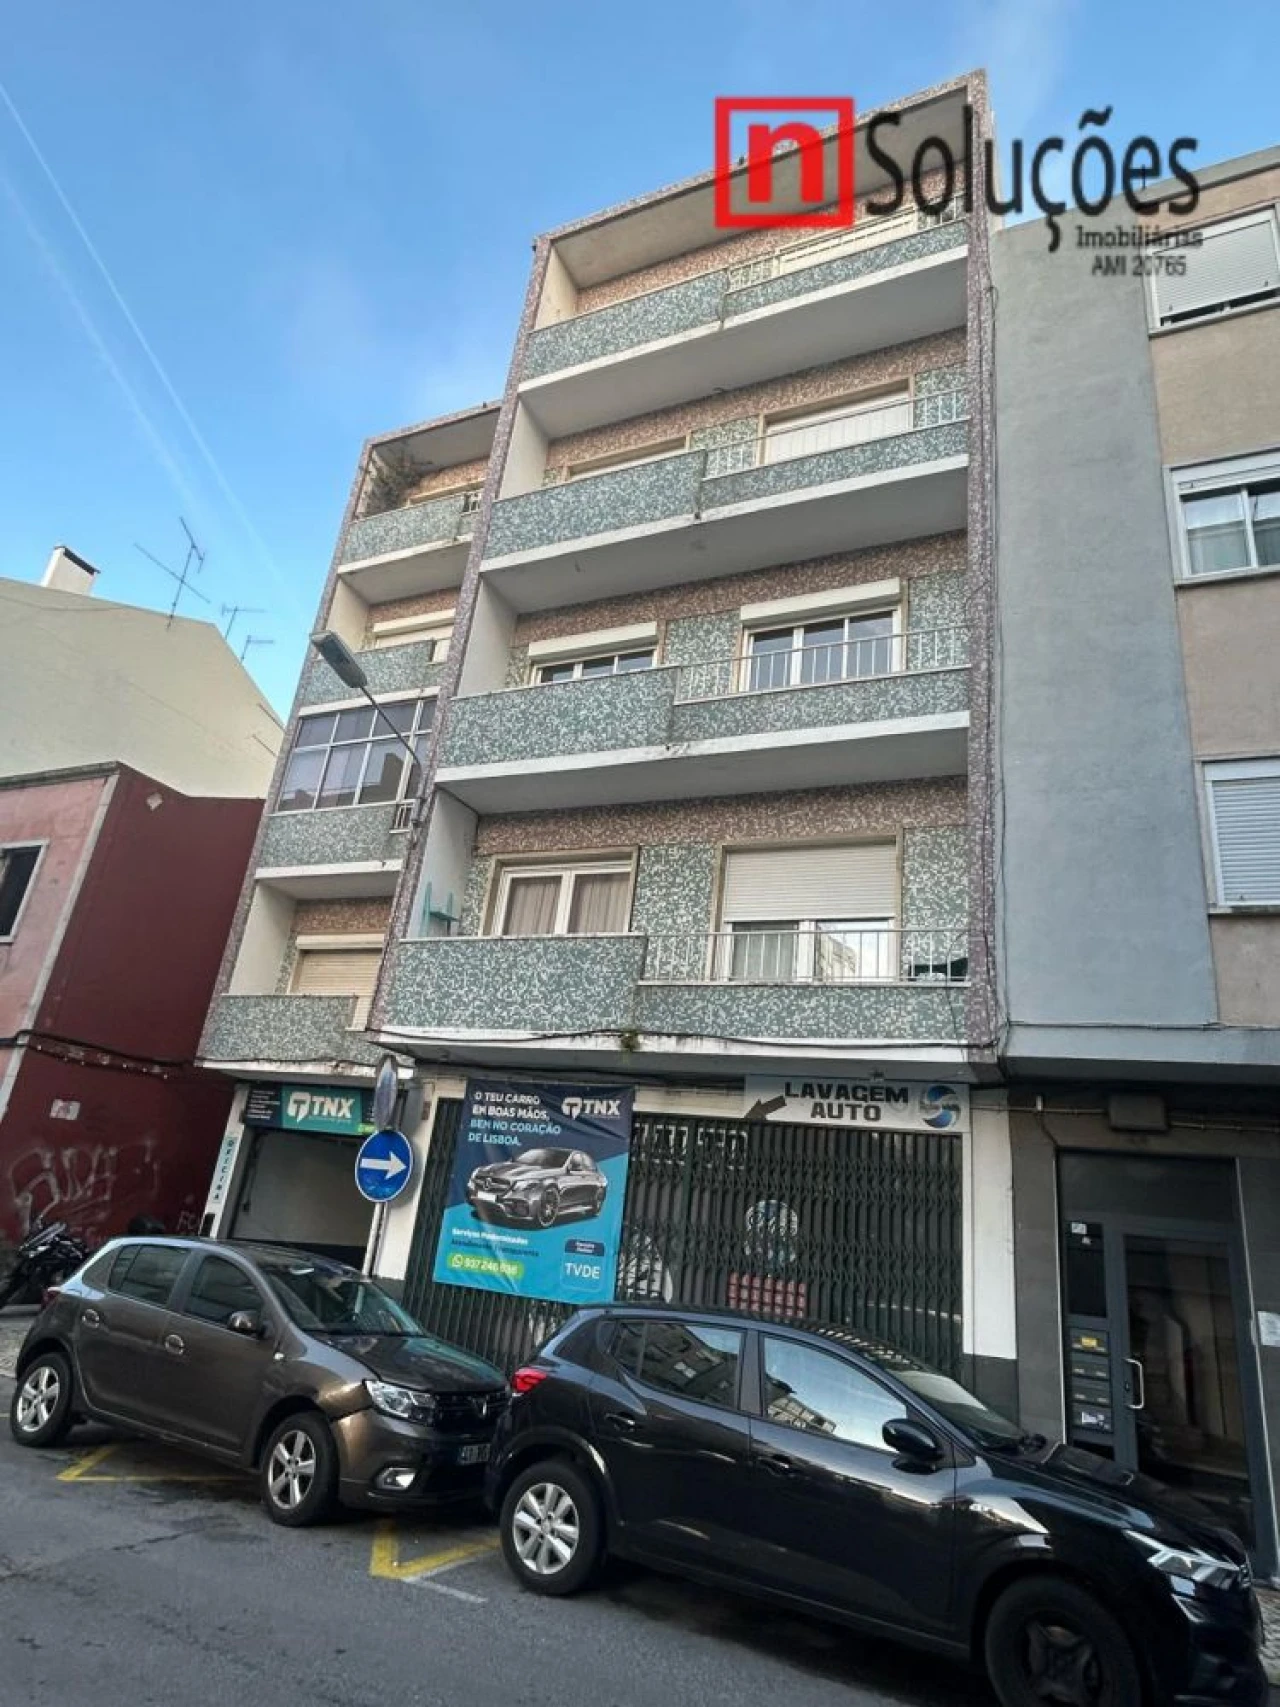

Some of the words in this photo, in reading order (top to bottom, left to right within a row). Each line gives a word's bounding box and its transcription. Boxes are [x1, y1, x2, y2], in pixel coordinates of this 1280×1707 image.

[505, 1093, 541, 1106] CARRO
[784, 1081, 909, 1103] LAVAGEM
[311, 1095, 355, 1119] TNX
[487, 1105, 516, 1118] BOAS
[583, 1099, 621, 1116] TNX
[810, 1102, 882, 1122] AUTO
[492, 1120, 509, 1132] NO
[510, 1121, 561, 1135] CORAÇÃO
[468, 1131, 482, 1143] DE
[564, 1262, 600, 1279] TVDE
